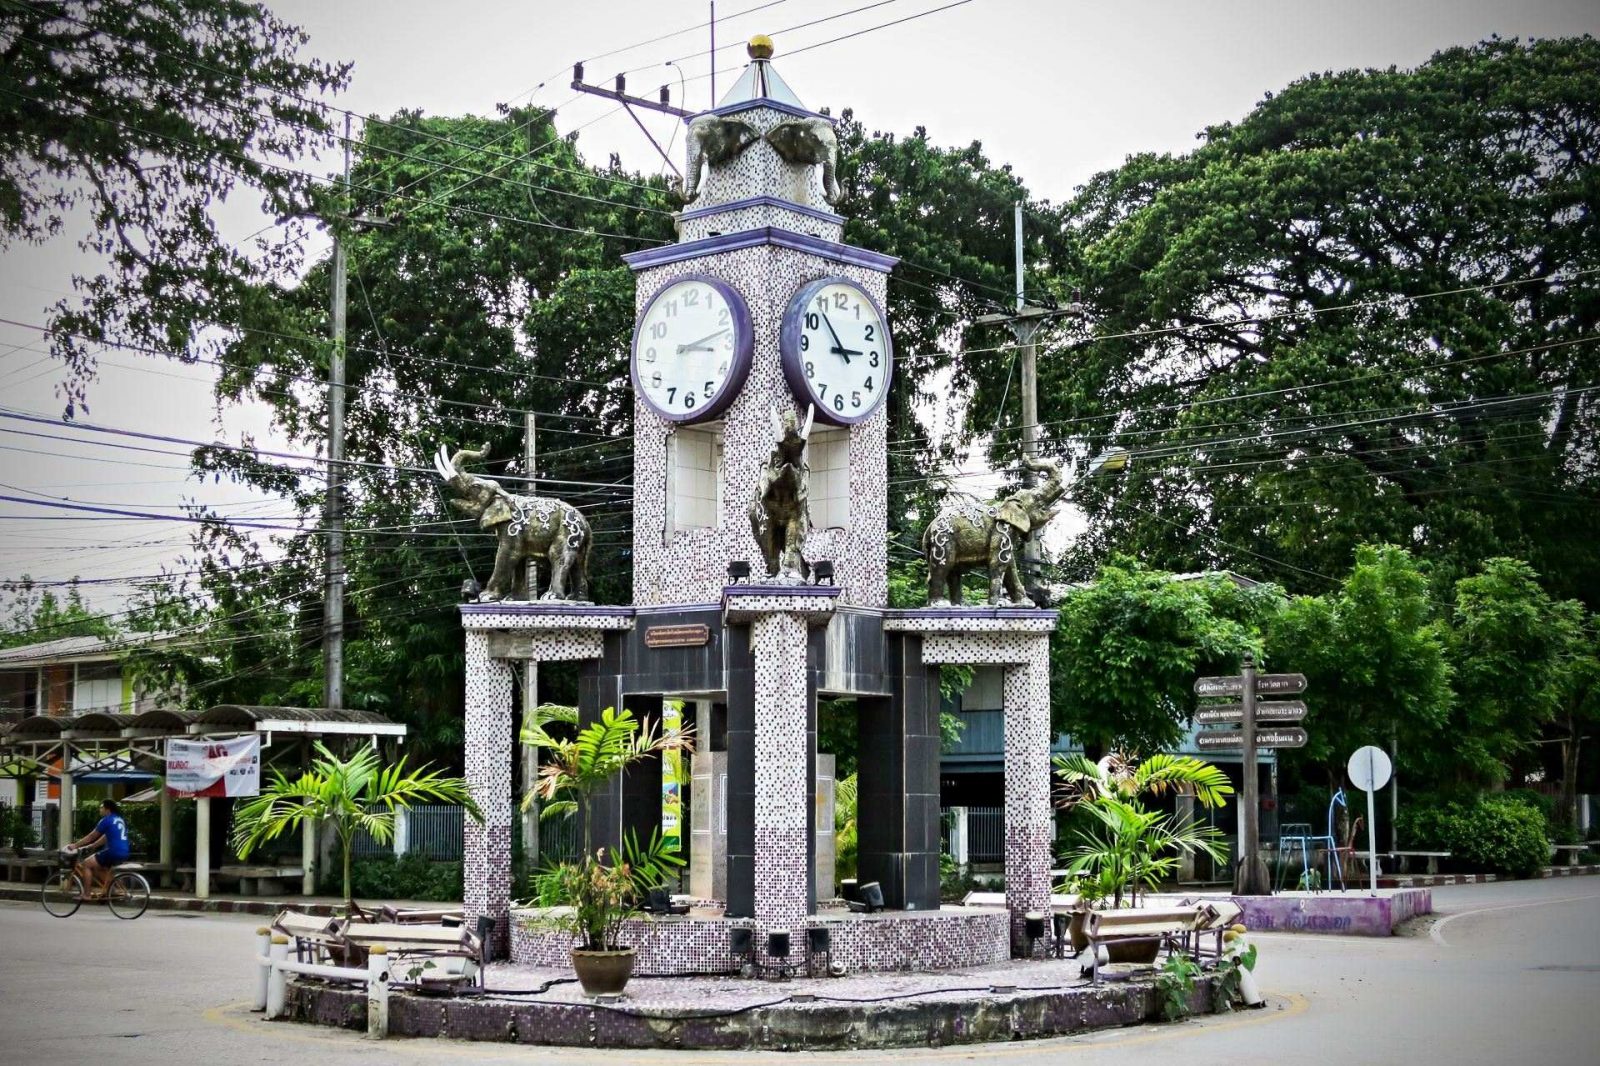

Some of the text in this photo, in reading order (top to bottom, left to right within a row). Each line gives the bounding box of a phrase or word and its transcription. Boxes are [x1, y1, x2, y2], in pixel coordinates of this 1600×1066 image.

[681, 288, 699, 307] 12
[705, 292, 713, 309] 1
[816, 295, 829, 313] 11
[832, 292, 848, 311] 12
[662, 300, 678, 318] 11
[718, 308, 730, 326] 2
[853, 303, 860, 320] 1
[804, 312, 819, 330] 10
[649, 321, 667, 340] 10
[864, 324, 875, 342] 2
[724, 333, 734, 351] 3
[800, 334, 809, 352] 9
[646, 347, 657, 363] 9
[869, 350, 879, 368] 3
[805, 361, 815, 379] 8
[652, 371, 662, 389] 8
[864, 375, 874, 393] 4
[666, 387, 677, 405] 7
[704, 381, 715, 399] 5
[818, 383, 828, 400] 7
[684, 391, 696, 409] 6
[833, 394, 844, 411] 6
[851, 391, 861, 408] 5
[117, 822, 127, 841] 2
